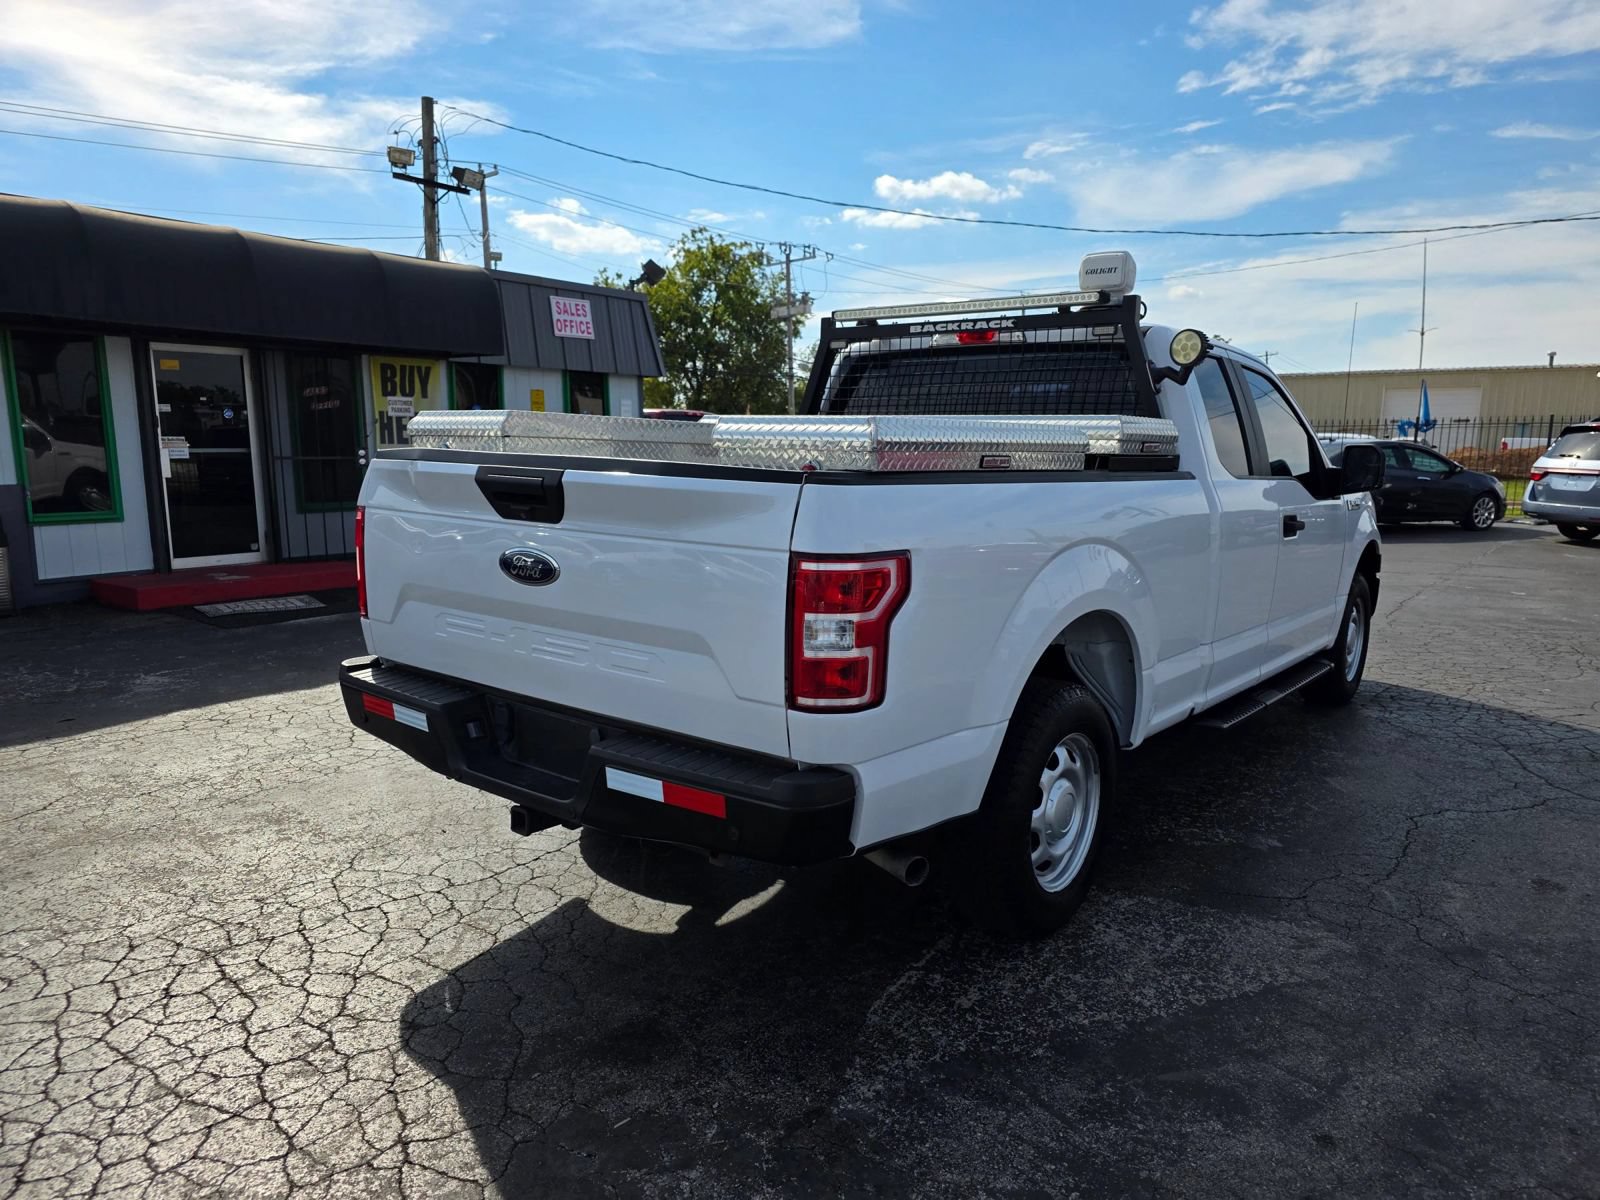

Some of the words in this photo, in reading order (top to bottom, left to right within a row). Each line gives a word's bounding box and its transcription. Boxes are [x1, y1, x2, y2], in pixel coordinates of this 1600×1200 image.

[1085, 266, 1118, 275] GOLIGHT
[555, 300, 588, 318] SALES
[556, 318, 592, 335] OFFICE
[909, 319, 1016, 333] BACKRACK
[380, 363, 432, 399] BUY
[391, 406, 411, 414] PARKING
[379, 410, 413, 444] HE
[510, 555, 543, 578] Ford
